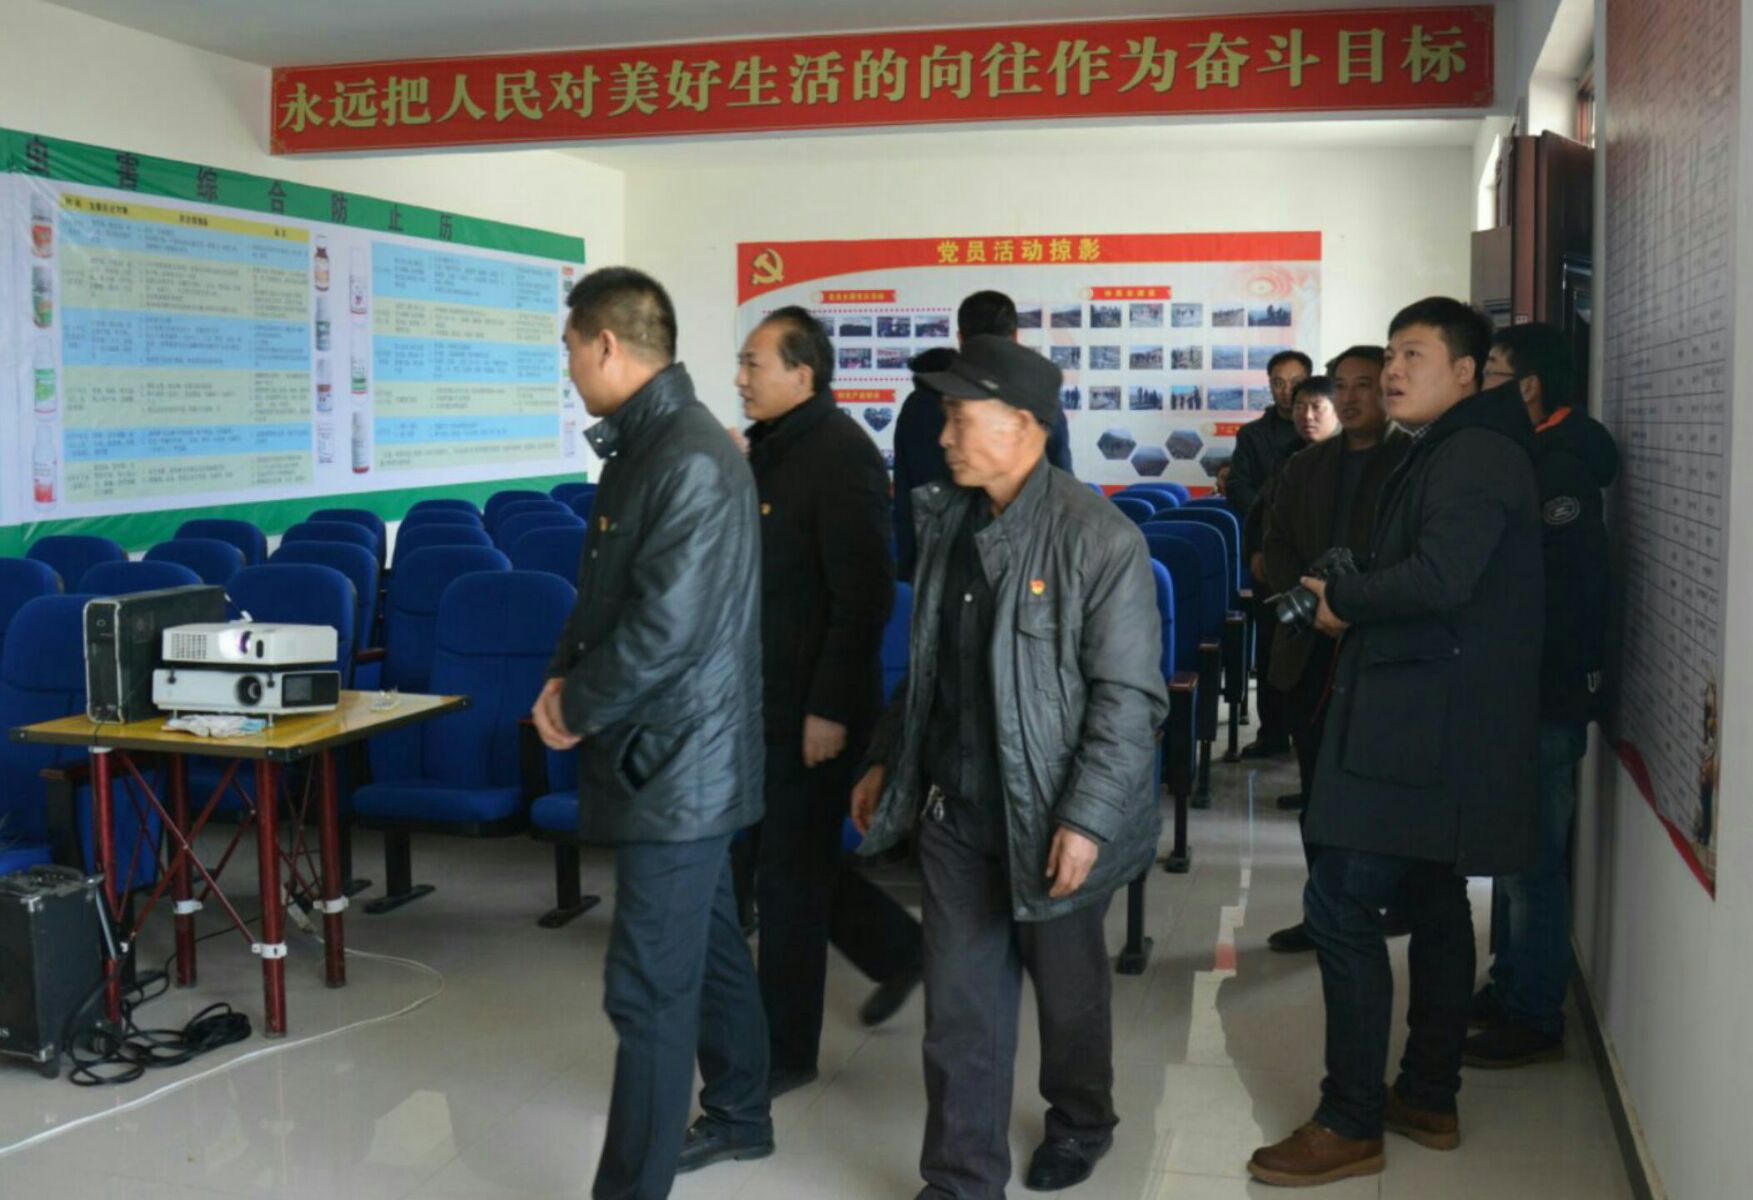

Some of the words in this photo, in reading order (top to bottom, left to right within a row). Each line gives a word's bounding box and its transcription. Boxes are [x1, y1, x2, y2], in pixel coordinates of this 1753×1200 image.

[278, 25, 1468, 132] 永远把人民对美好生活的向往作为奋斗目标
[937, 238, 1100, 263] 党员活动掠影
